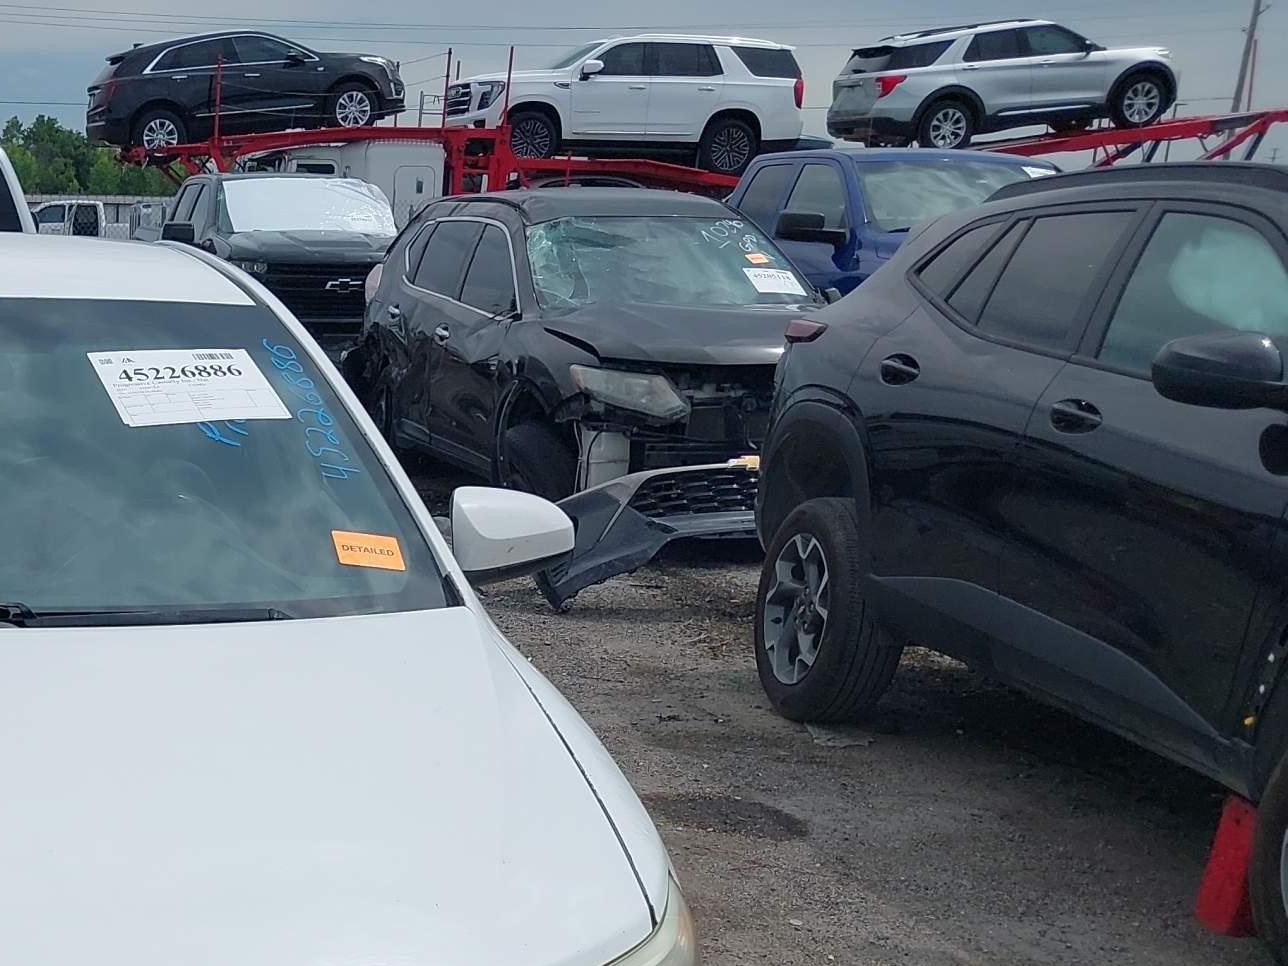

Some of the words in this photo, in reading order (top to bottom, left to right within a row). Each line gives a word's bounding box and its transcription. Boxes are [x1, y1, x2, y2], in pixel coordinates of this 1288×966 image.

[118, 363, 243, 383] 45226886
[262, 337, 361, 481] 45226886
[341, 544, 395, 557] DETAILED
